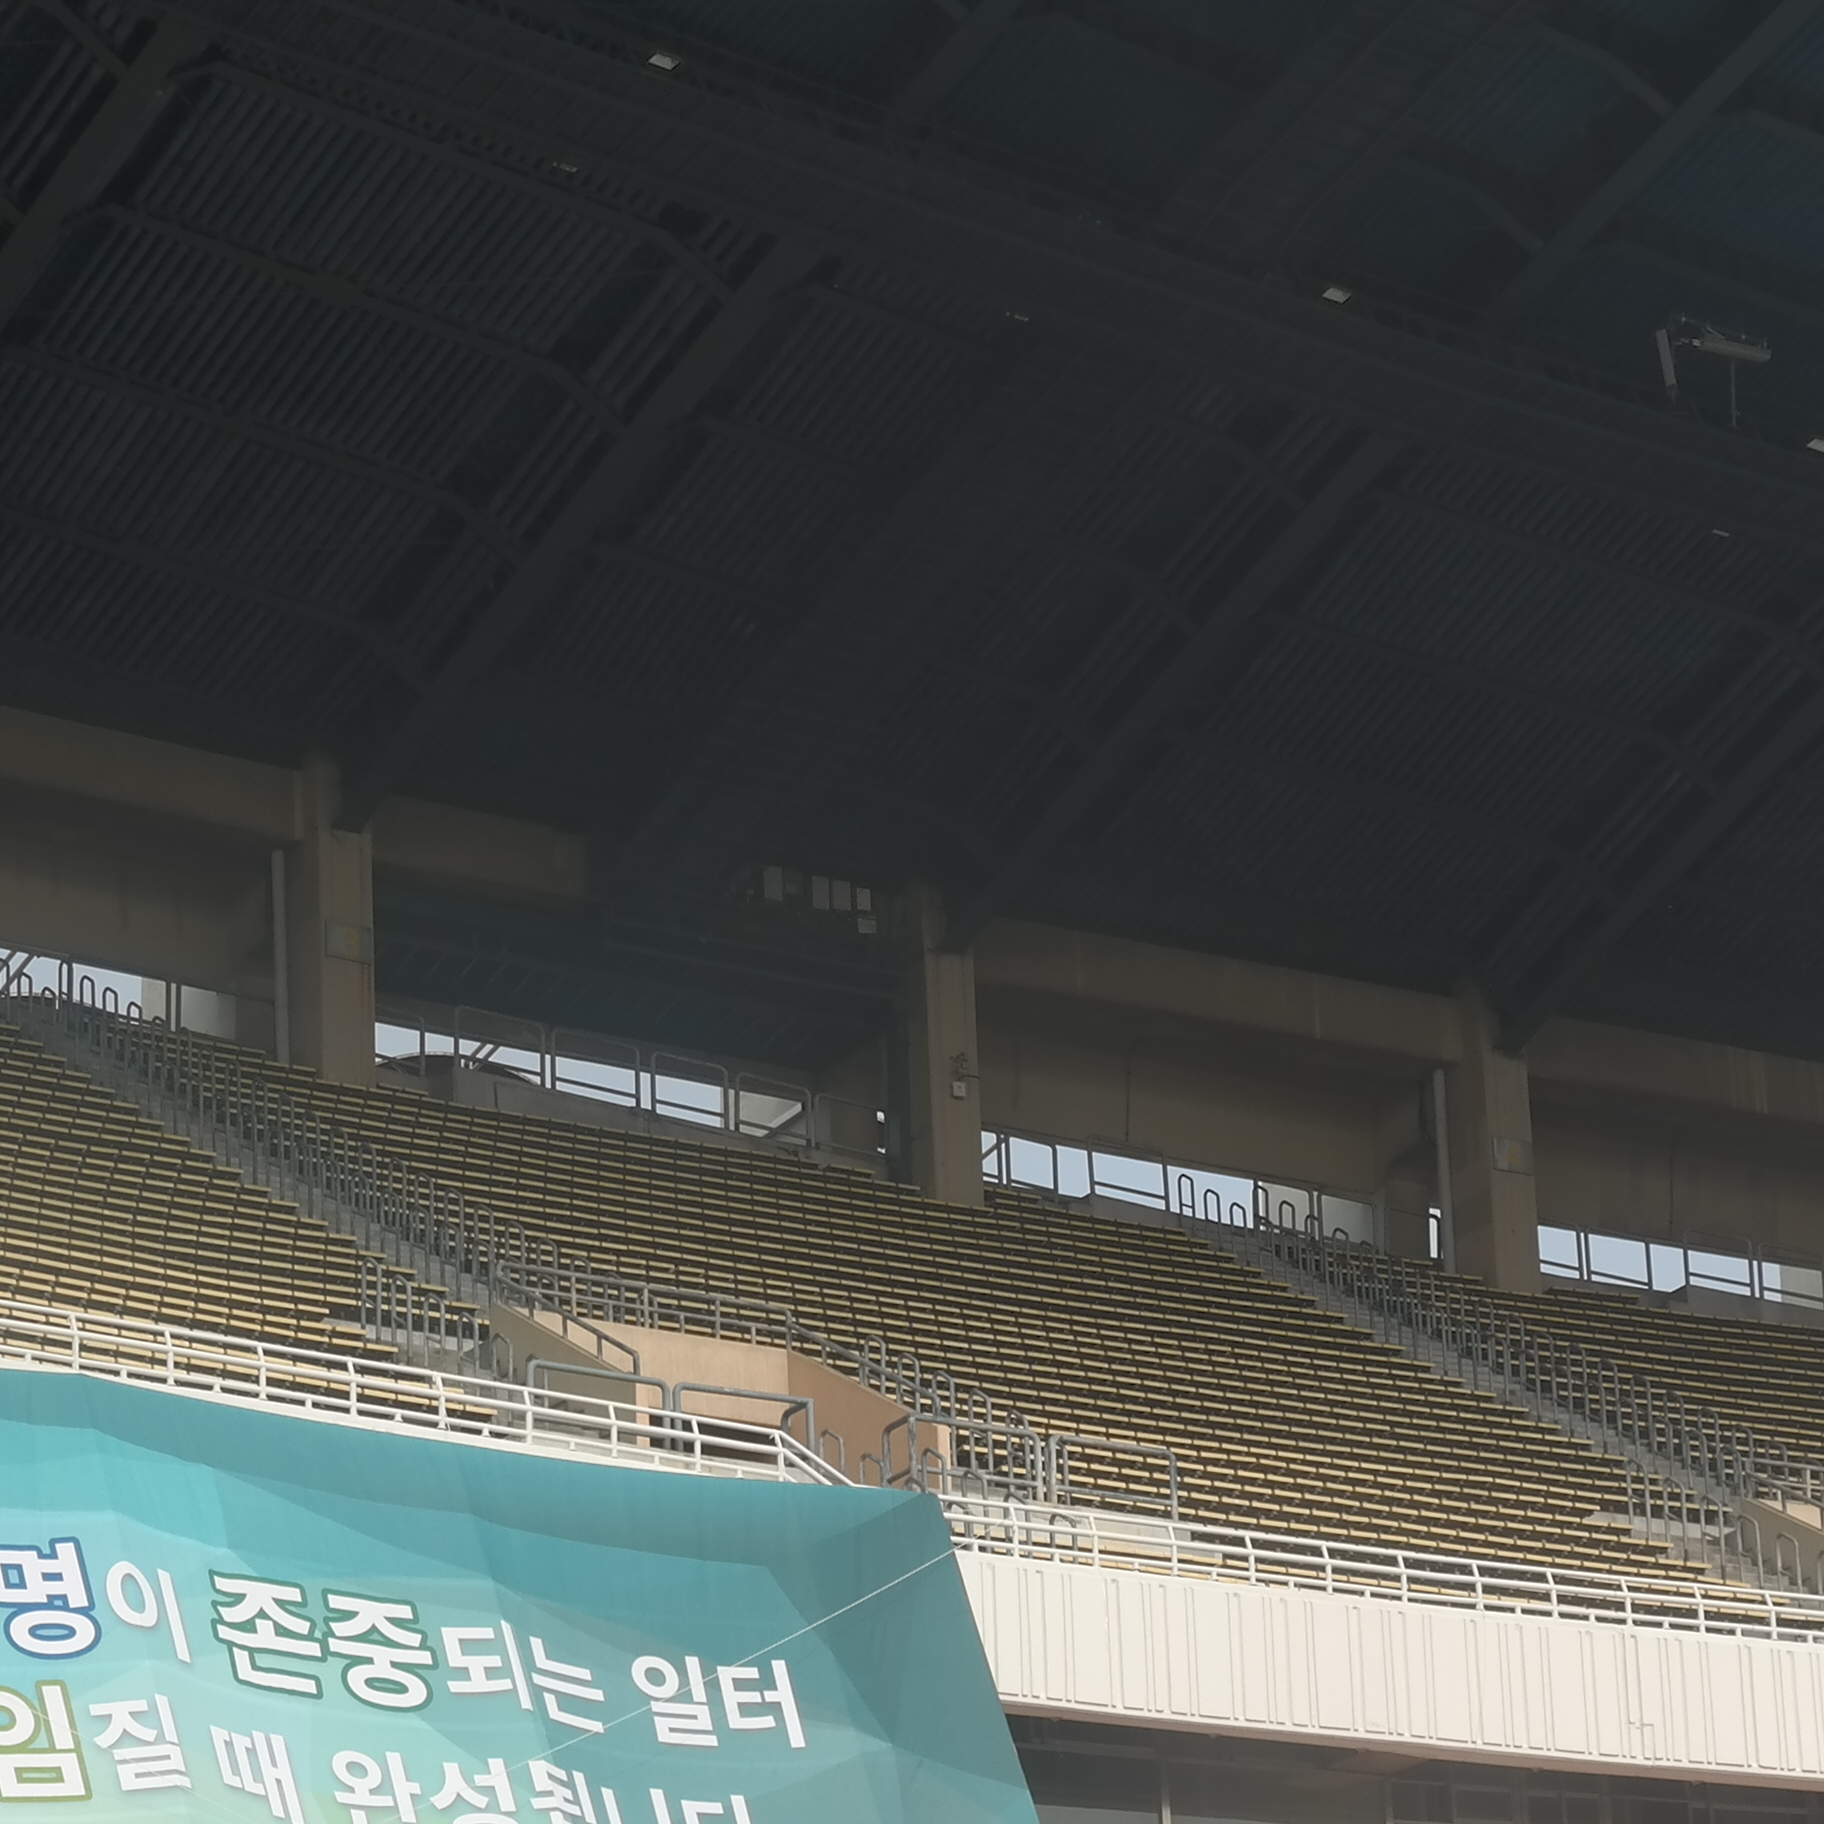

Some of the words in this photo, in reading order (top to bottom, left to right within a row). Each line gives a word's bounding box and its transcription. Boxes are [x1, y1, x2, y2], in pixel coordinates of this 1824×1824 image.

[211, 1569, 608, 1737] 존중되는
[629, 1655, 808, 1754] 일터
[208, 1724, 308, 1824] 때
